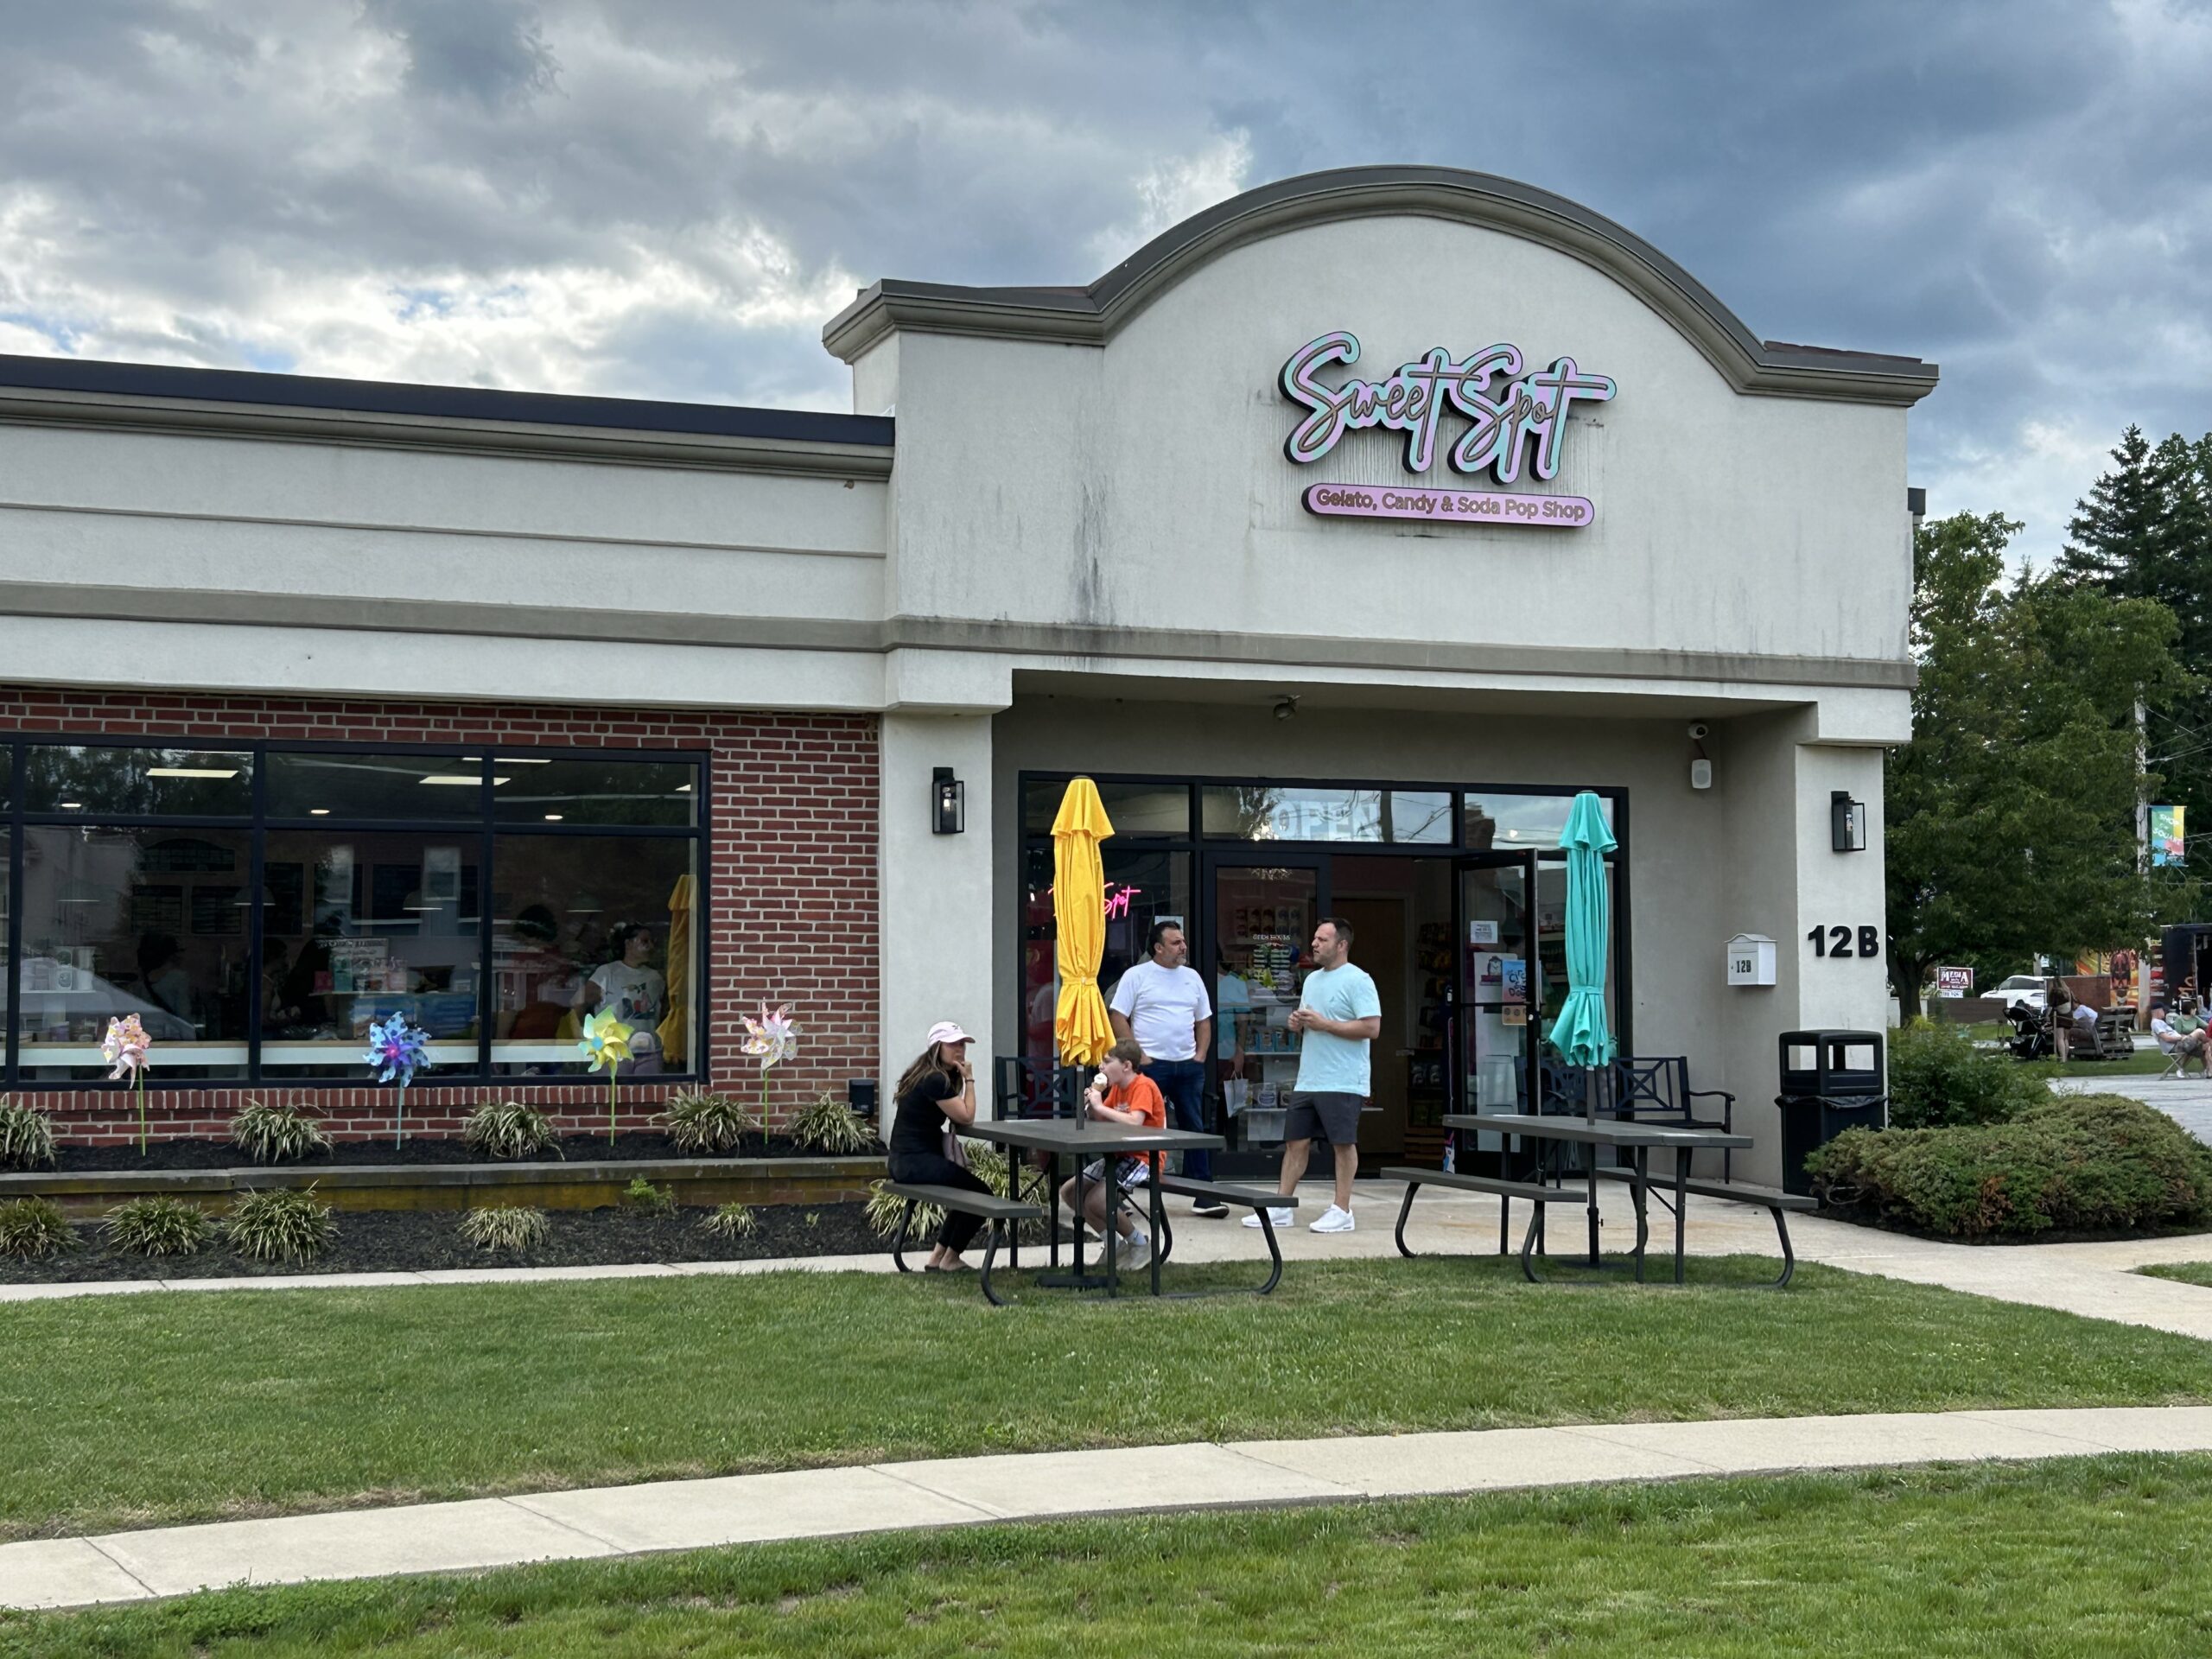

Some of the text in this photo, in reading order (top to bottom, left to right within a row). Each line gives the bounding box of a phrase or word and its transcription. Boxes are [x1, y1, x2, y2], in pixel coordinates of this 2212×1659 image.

[1284, 333, 1615, 482] Sweet Spot
[1316, 488, 1586, 522] Gelato, Candy & Soda Pop Shop
[1271, 800, 1381, 842] OPEN
[1808, 925, 1879, 957] 12B
[1737, 960, 1751, 973] 12B
